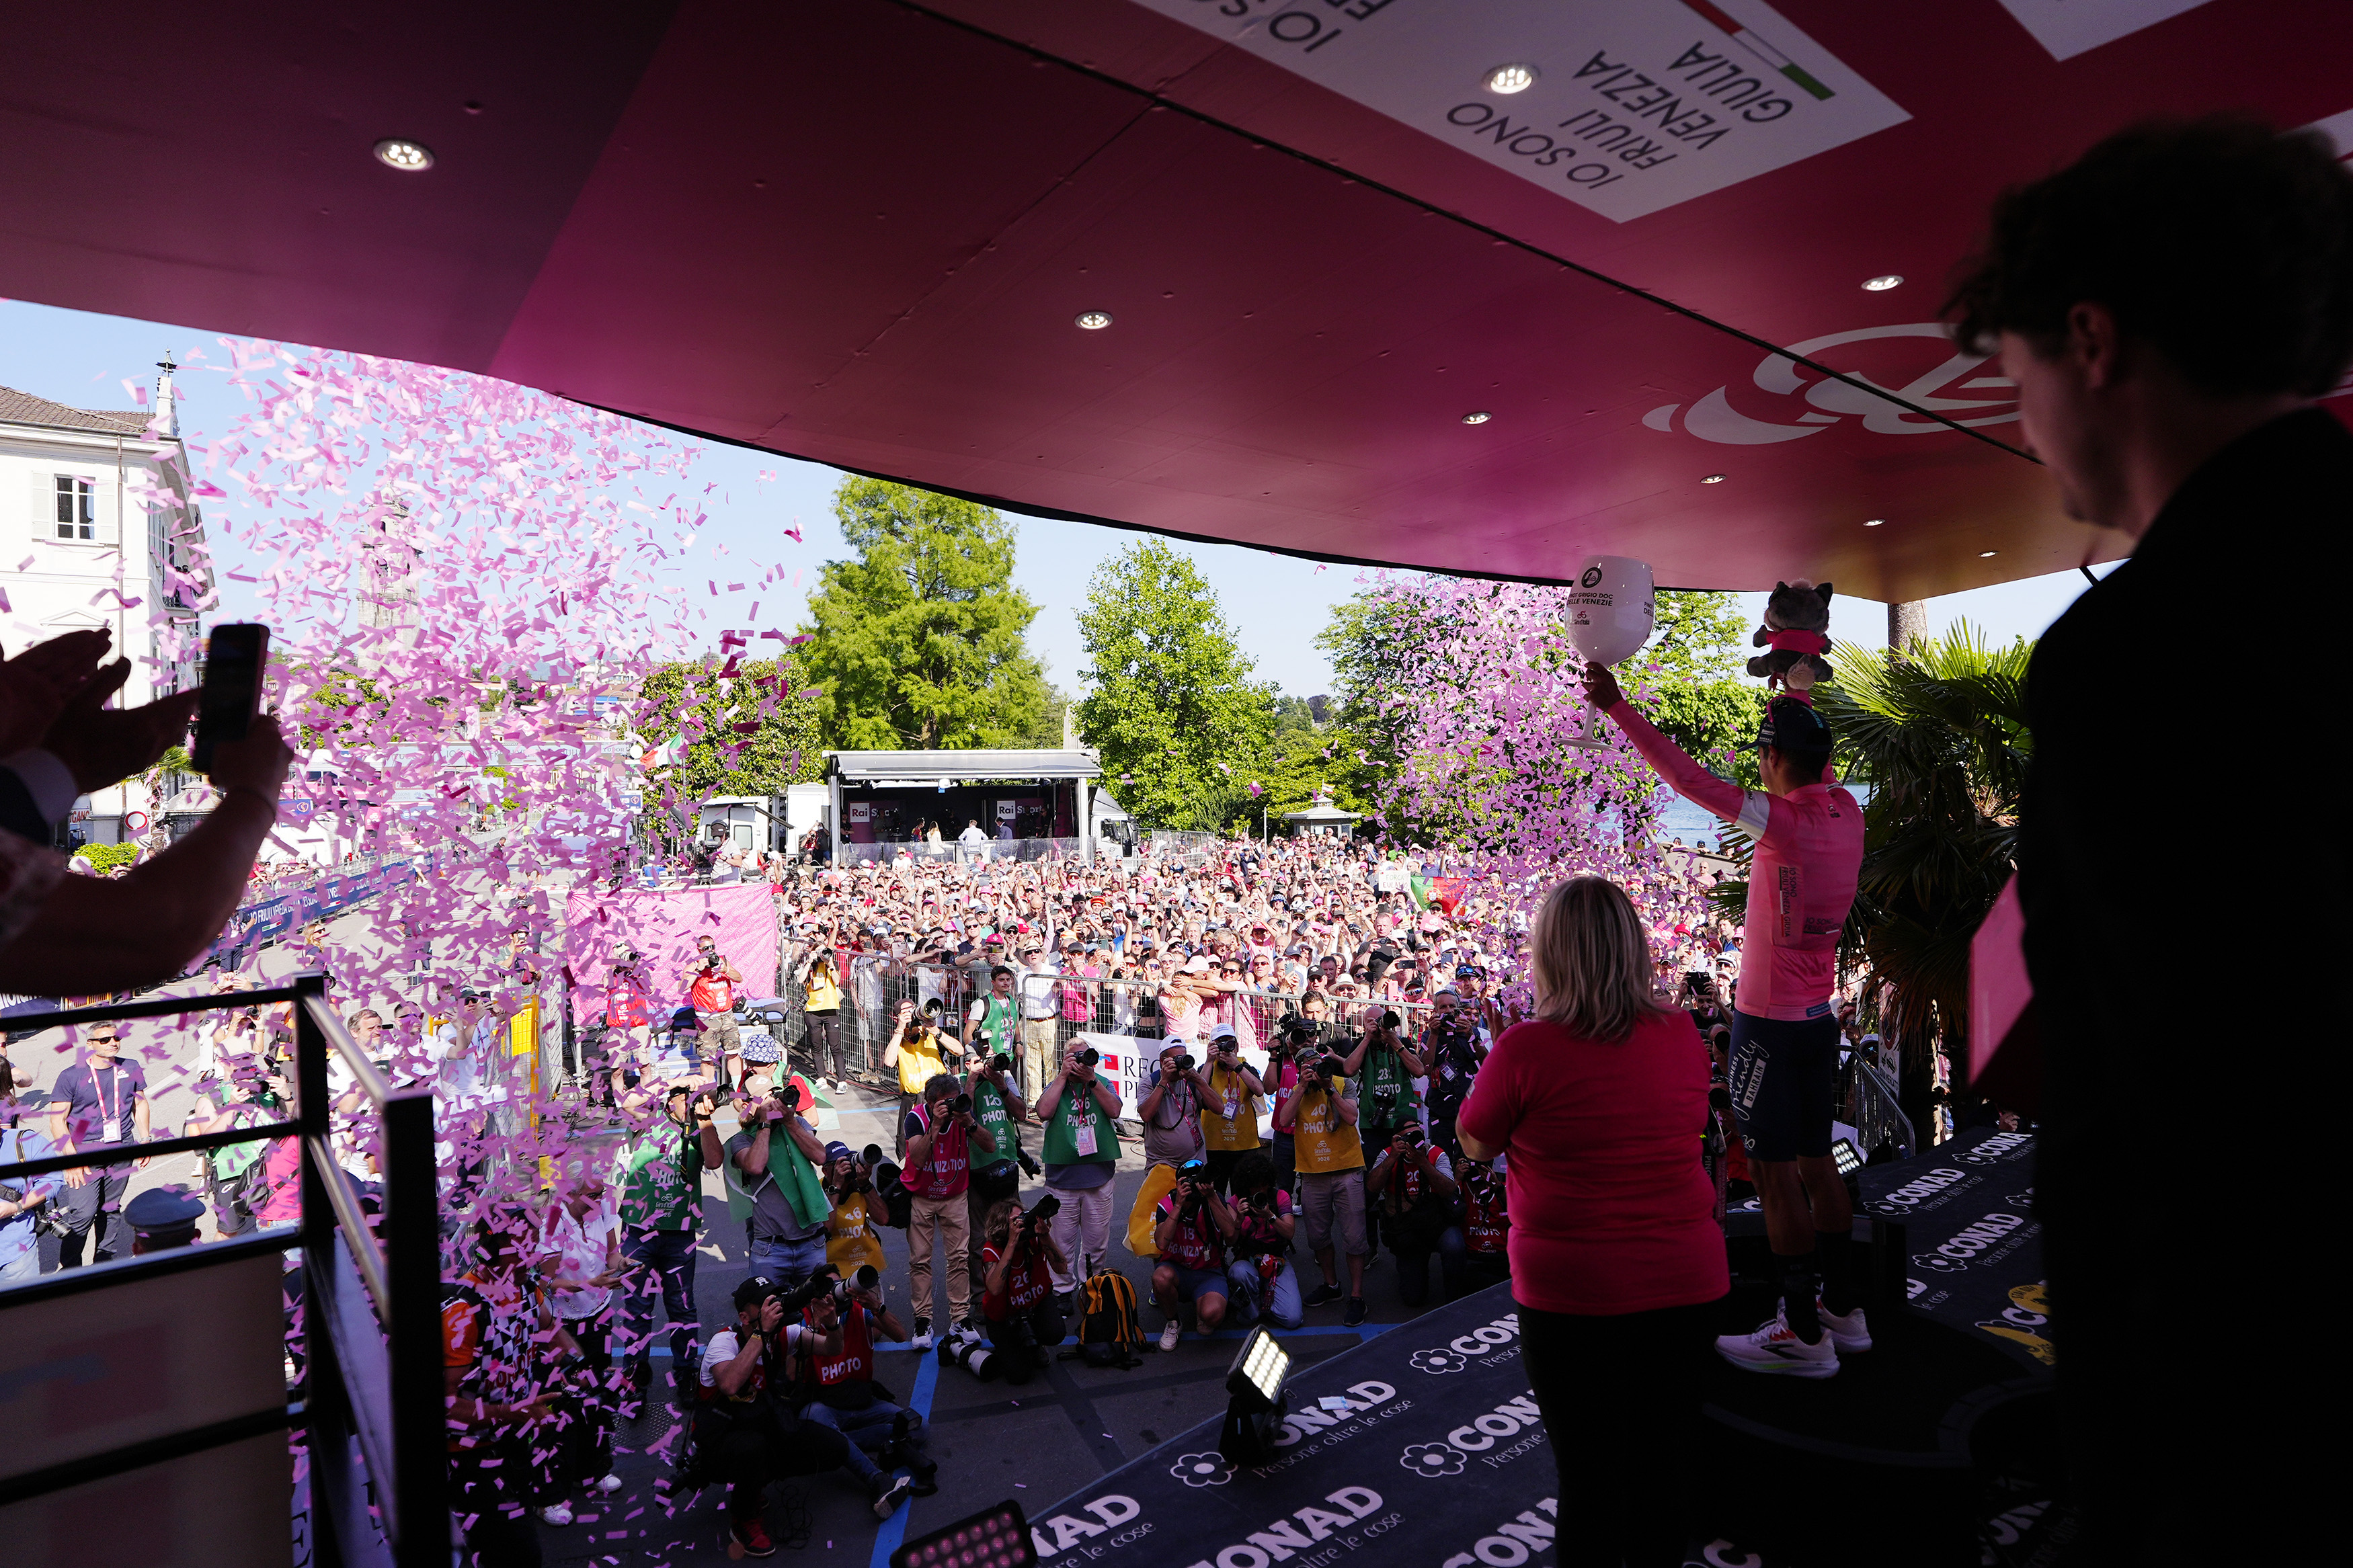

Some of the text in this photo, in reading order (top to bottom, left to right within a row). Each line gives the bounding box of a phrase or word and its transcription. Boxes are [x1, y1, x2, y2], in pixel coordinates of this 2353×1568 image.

[1666, 40, 1794, 123] GIULIA
[1572, 50, 1731, 151] VENEZIA
[1446, 102, 1624, 190] IO SONO
[1558, 108, 1679, 171] FRIULI
[1582, 598, 1613, 606] VENEZIE
[852, 809, 868, 817] Rai
[998, 806, 1014, 815] Rai
[1781, 866, 1790, 885] FRIULI
[1789, 875, 1798, 898] SONO
[1782, 885, 1791, 915] VENEZIA
[1222, 1087, 1238, 1100] 44
[1745, 1064, 1764, 1102] BAHRAIN
[983, 1094, 1002, 1107] 120
[1070, 1097, 1090, 1110] 26
[1310, 1103, 1327, 1116] 40
[1970, 1132, 2033, 1156] CONA
[1885, 1168, 1966, 1205] CONAD
[1183, 1227, 1195, 1241] 18
[1936, 1212, 2024, 1258] CONAD
[1010, 1284, 1044, 1307] PHOTO
[822, 1357, 862, 1382] PHOTO
[1273, 1380, 1396, 1446] ONAD
[1447, 1389, 1542, 1451] CON
[1251, 1399, 1415, 1479] Persone oltre le cose
[1481, 1434, 1546, 1469] Persone
[1079, 1522, 1156, 1561] le cose
[1335, 1535, 1364, 1551] le
[1363, 1512, 1406, 1538] cose
